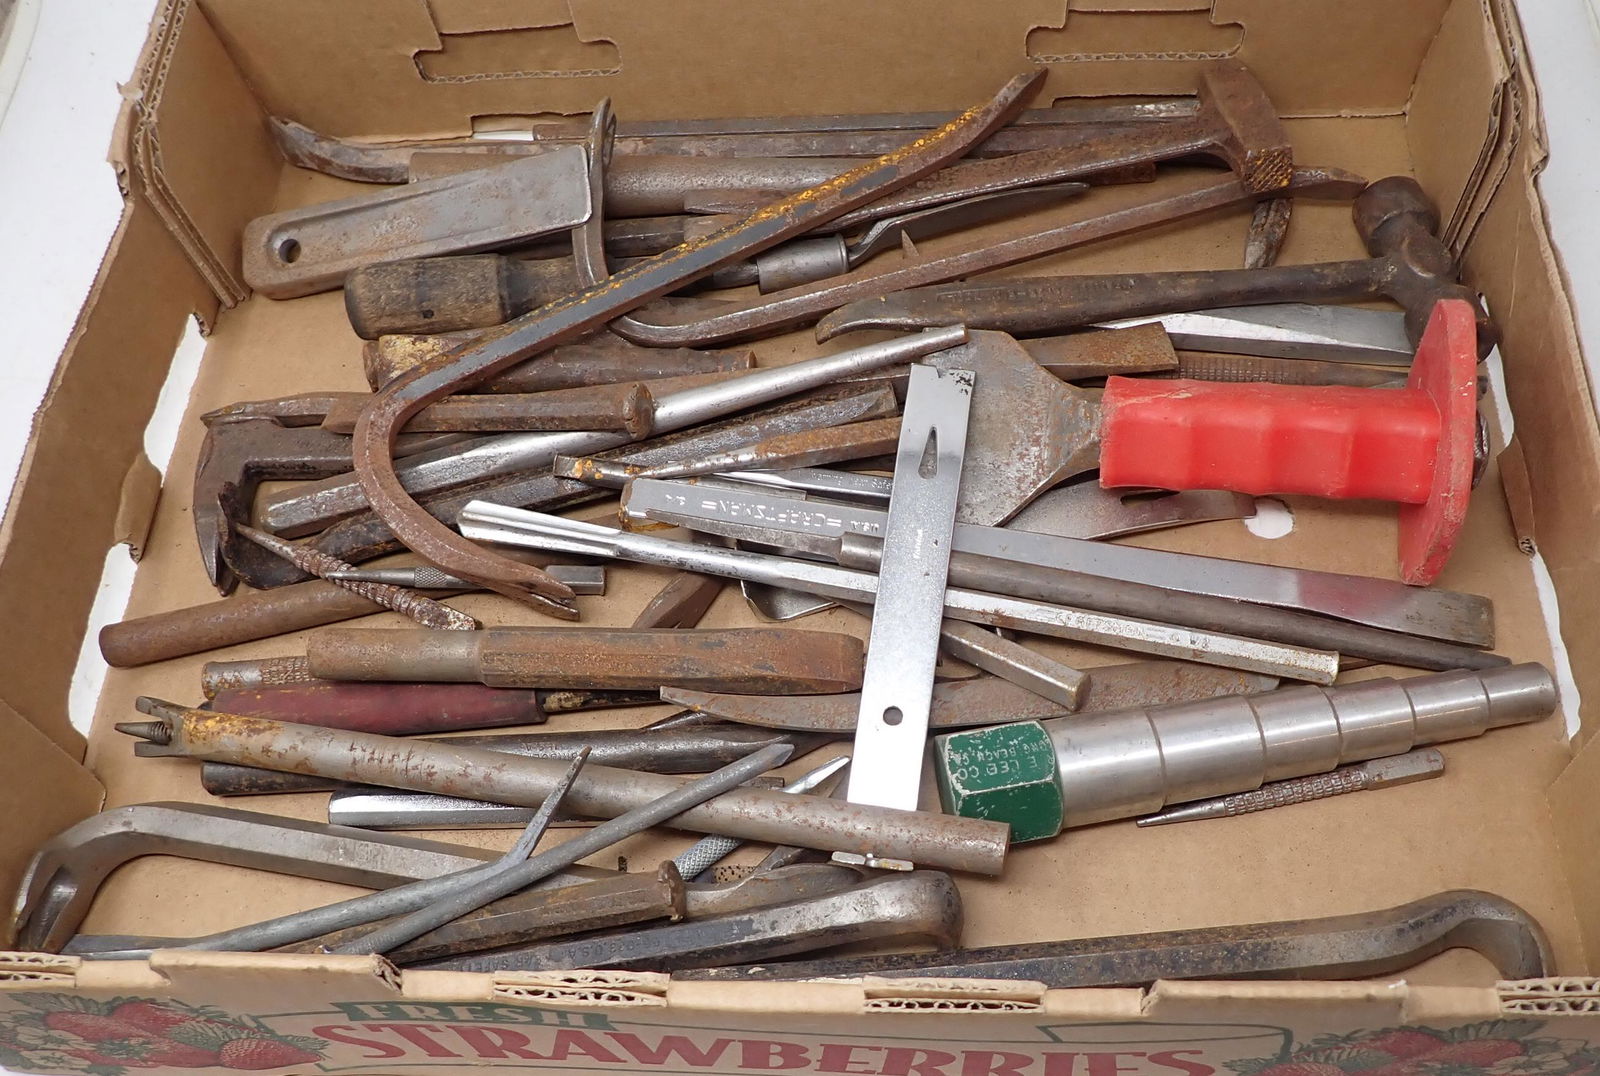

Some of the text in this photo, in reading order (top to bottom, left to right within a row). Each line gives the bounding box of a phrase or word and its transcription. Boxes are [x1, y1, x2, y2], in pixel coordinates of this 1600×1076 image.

[986, 759, 1020, 776] LEE
[351, 1003, 585, 1027] FRESH
[312, 1022, 1216, 1076] STRAWBERRIES
